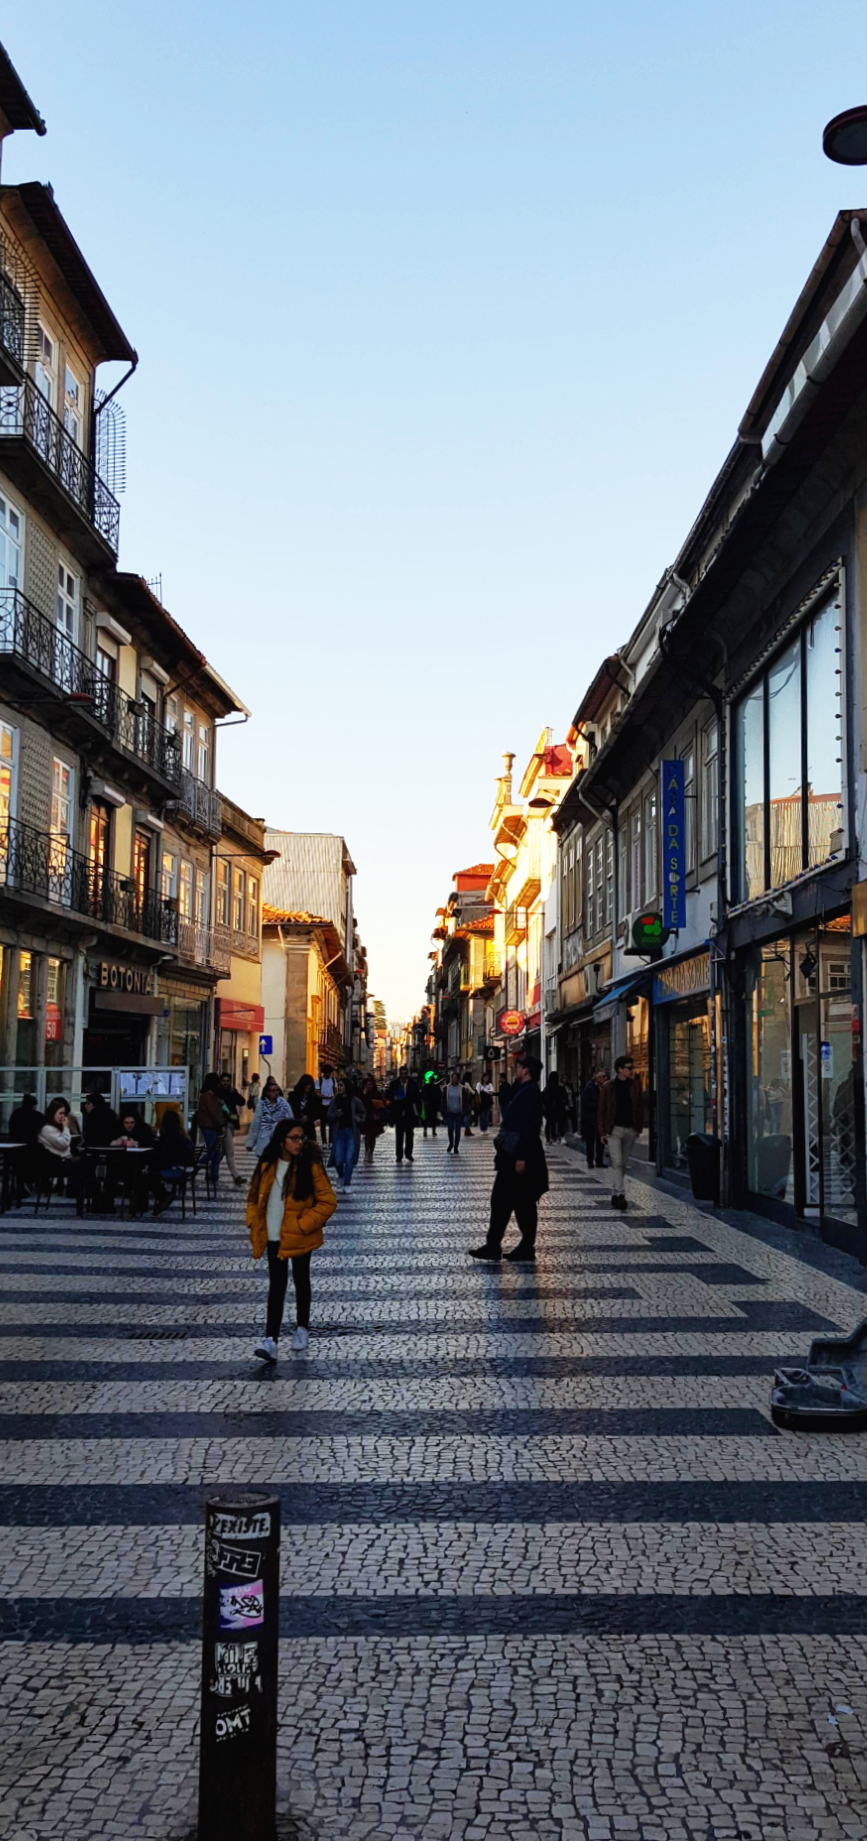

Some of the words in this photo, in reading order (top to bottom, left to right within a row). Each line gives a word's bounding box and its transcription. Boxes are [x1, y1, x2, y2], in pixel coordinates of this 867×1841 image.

[667, 825, 680, 850] DA
[675, 961, 686, 993] DA
[686, 954, 710, 990] SORTE
